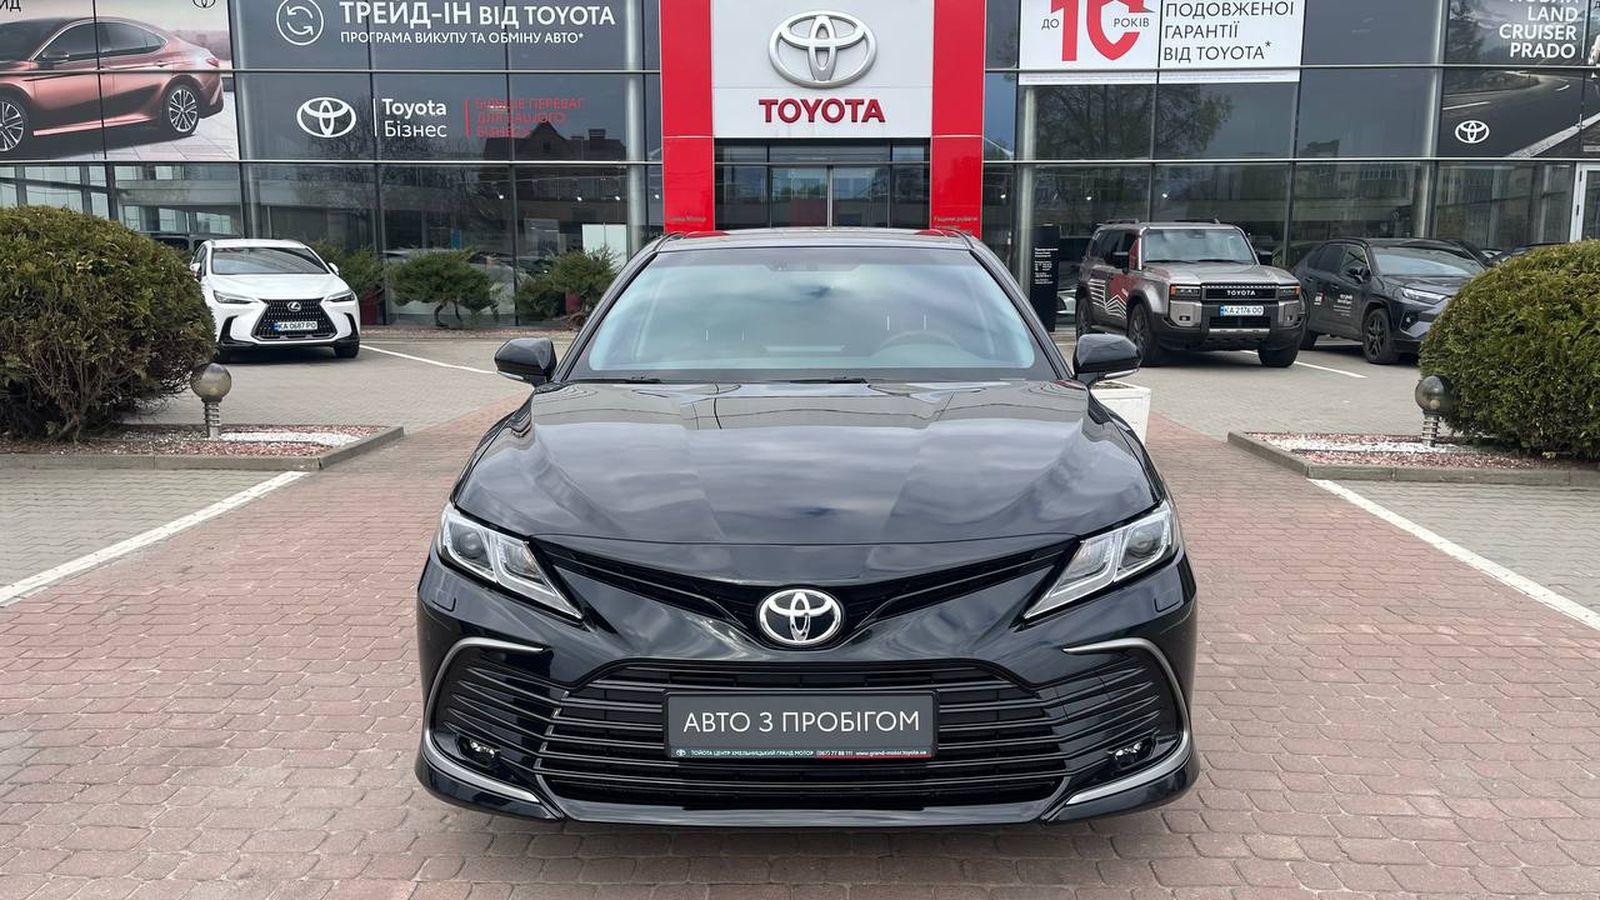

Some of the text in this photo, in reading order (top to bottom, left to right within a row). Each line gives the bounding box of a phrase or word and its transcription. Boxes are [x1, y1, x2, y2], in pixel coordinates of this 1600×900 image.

[479, 6, 519, 29] ВІД
[523, 6, 616, 25] TOYOTA
[1527, 6, 1578, 21] LAND
[1041, 19, 1060, 30] ДО
[1113, 17, 1150, 28] РОКІВ
[1165, 21, 1240, 39] ГАРАНТІЇ
[1499, 24, 1577, 40] CRUISER
[340, 31, 412, 43] ПРОГРАМА
[415, 31, 468, 43] ВИКУПУ
[470, 32, 486, 43] ТА
[488, 31, 541, 43] ОБМІНУ
[1164, 46, 1191, 63] ВІД
[1510, 42, 1576, 59] PRADO
[382, 98, 447, 119] Toyota
[758, 98, 886, 123] TOYOTA
[384, 120, 447, 138] Бізнес
[683, 711, 751, 733] АВТО
[782, 710, 919, 733] ПРОБІГОМ
